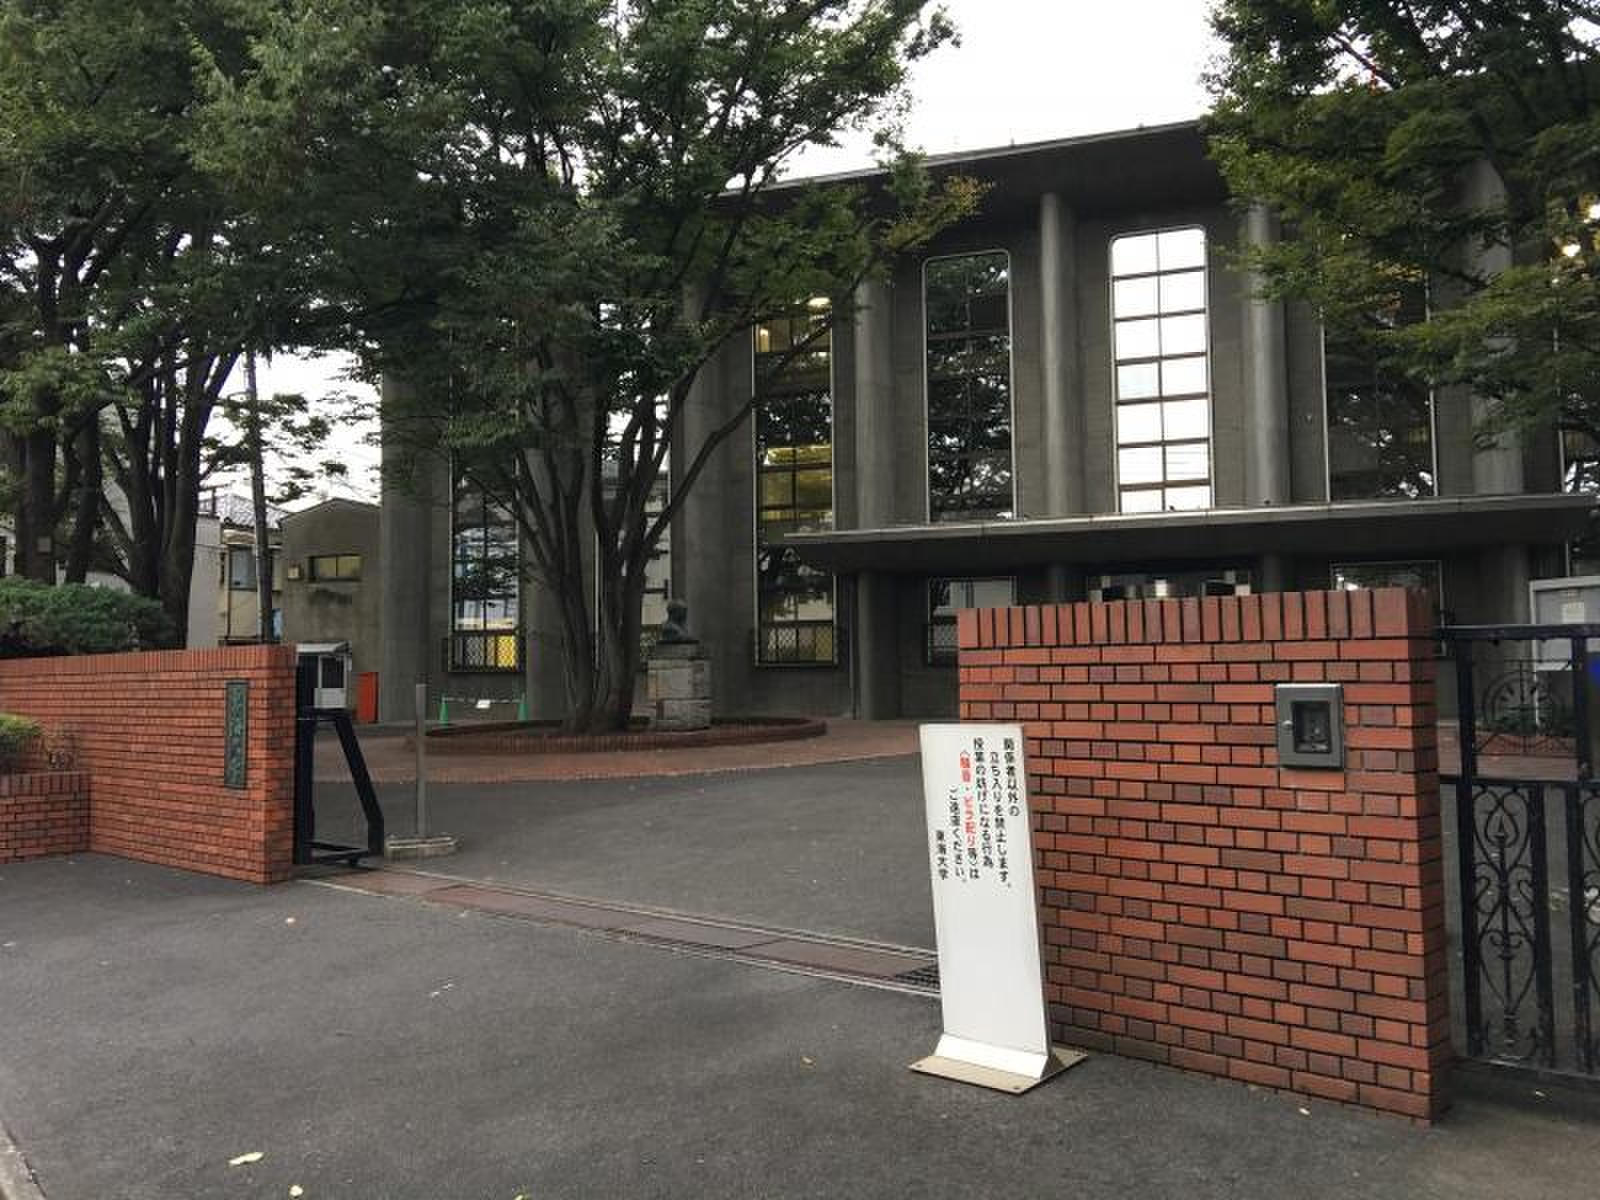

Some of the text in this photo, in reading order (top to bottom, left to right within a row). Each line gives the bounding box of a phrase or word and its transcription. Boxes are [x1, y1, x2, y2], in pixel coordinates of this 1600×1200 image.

[991, 752, 1011, 887] 立ち入りを禁止します。
[1003, 738, 1020, 817] 関係者以外の
